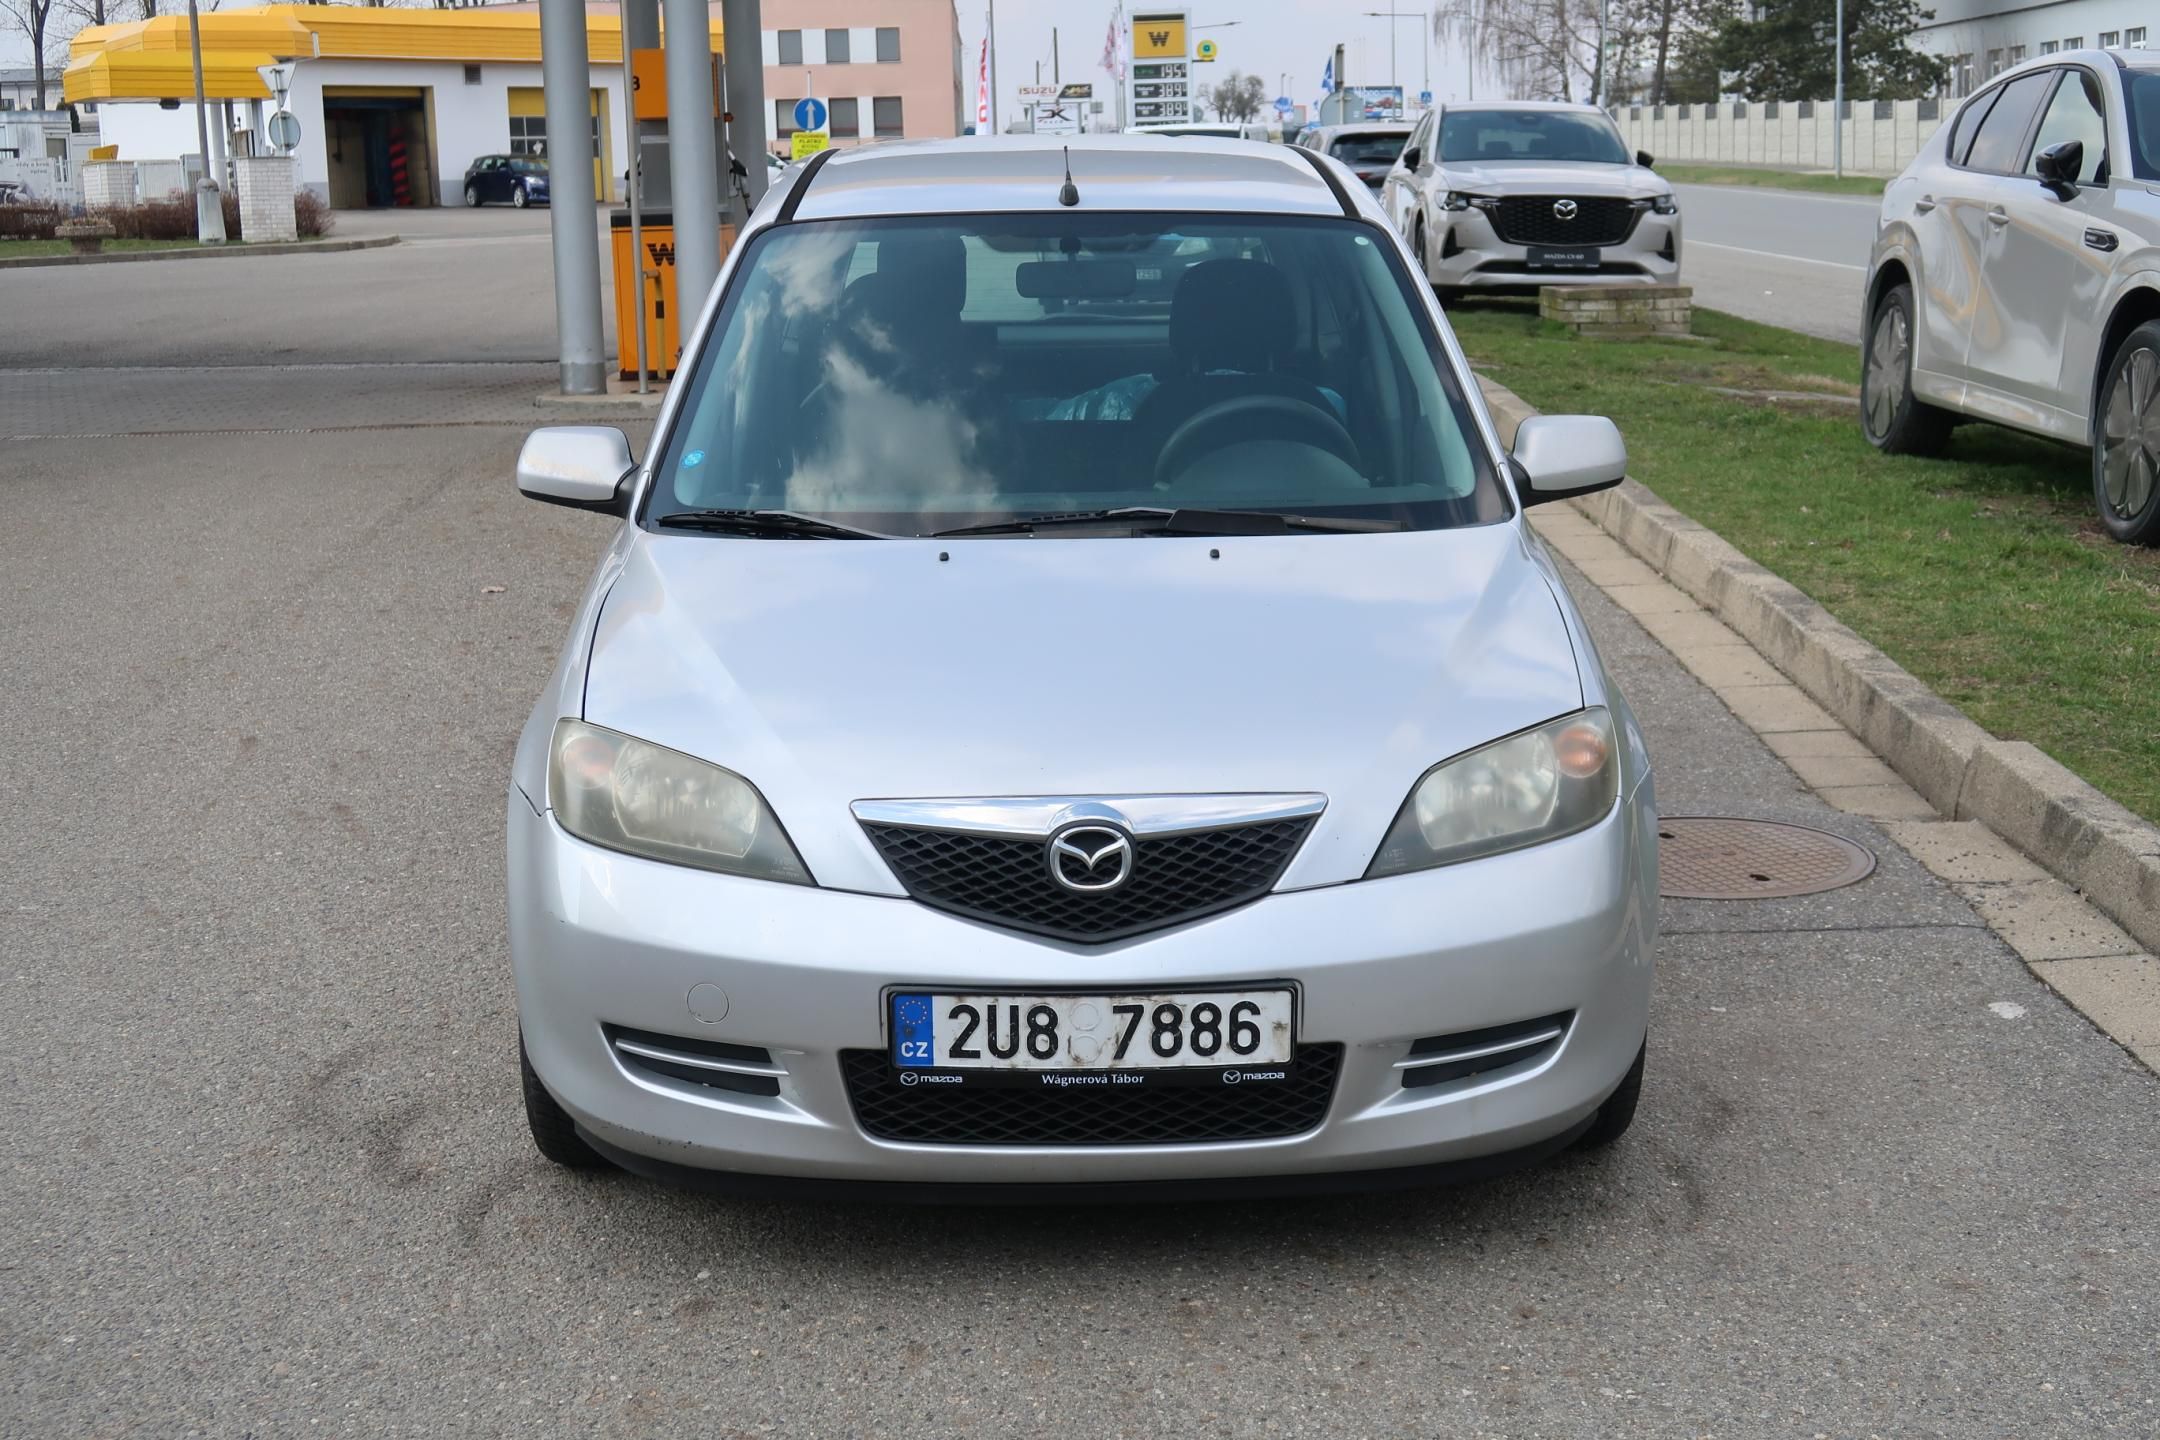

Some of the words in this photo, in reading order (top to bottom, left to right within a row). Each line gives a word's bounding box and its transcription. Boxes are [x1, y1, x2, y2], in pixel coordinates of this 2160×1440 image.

[1019, 86, 1057, 95] ISUZU
[949, 1004, 1059, 1060] 2U8
[1113, 1001, 1260, 1060] 7886
[901, 1042, 928, 1057] CZ
[1041, 1074, 1108, 1087] Wágnerová
[1111, 1074, 1144, 1084] Tábor
